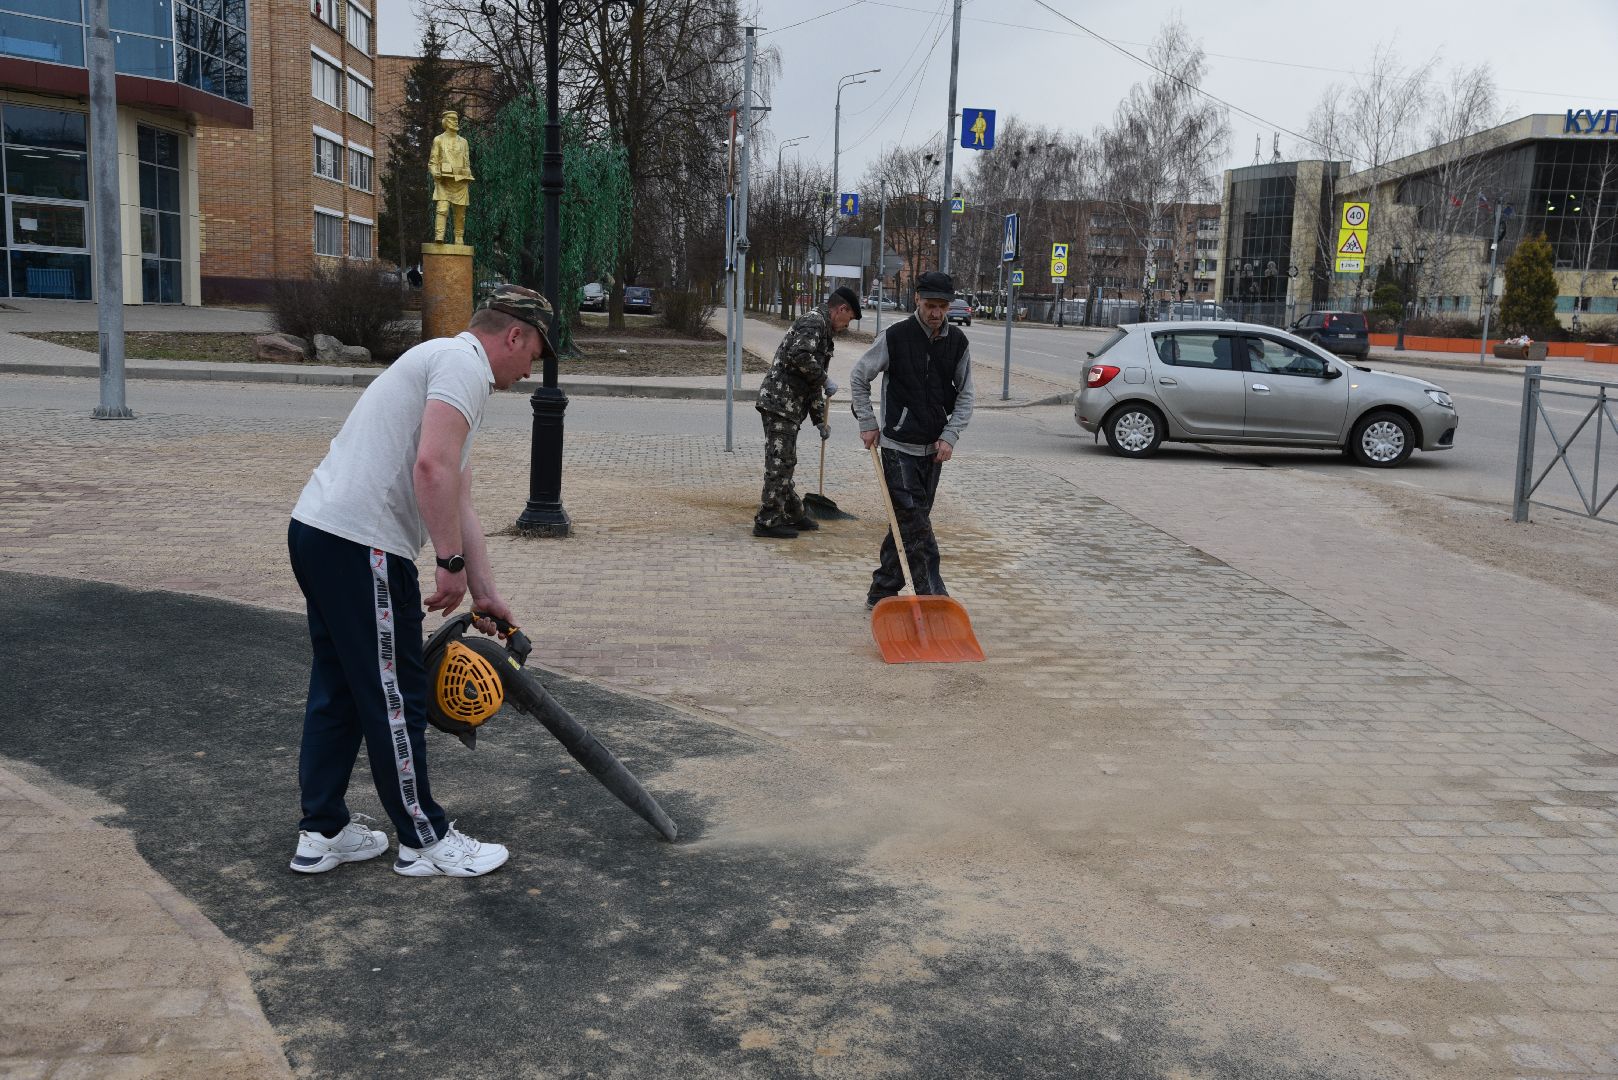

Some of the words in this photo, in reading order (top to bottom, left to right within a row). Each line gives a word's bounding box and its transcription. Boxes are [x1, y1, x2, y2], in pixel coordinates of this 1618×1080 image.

[1565, 109, 1618, 133] КУЛ
[1349, 211, 1362, 220] 40
[380, 631, 393, 661] PUMA
[384, 680, 401, 710] PUMA
[393, 728, 410, 760] PUMA
[402, 778, 416, 806] PUMA
